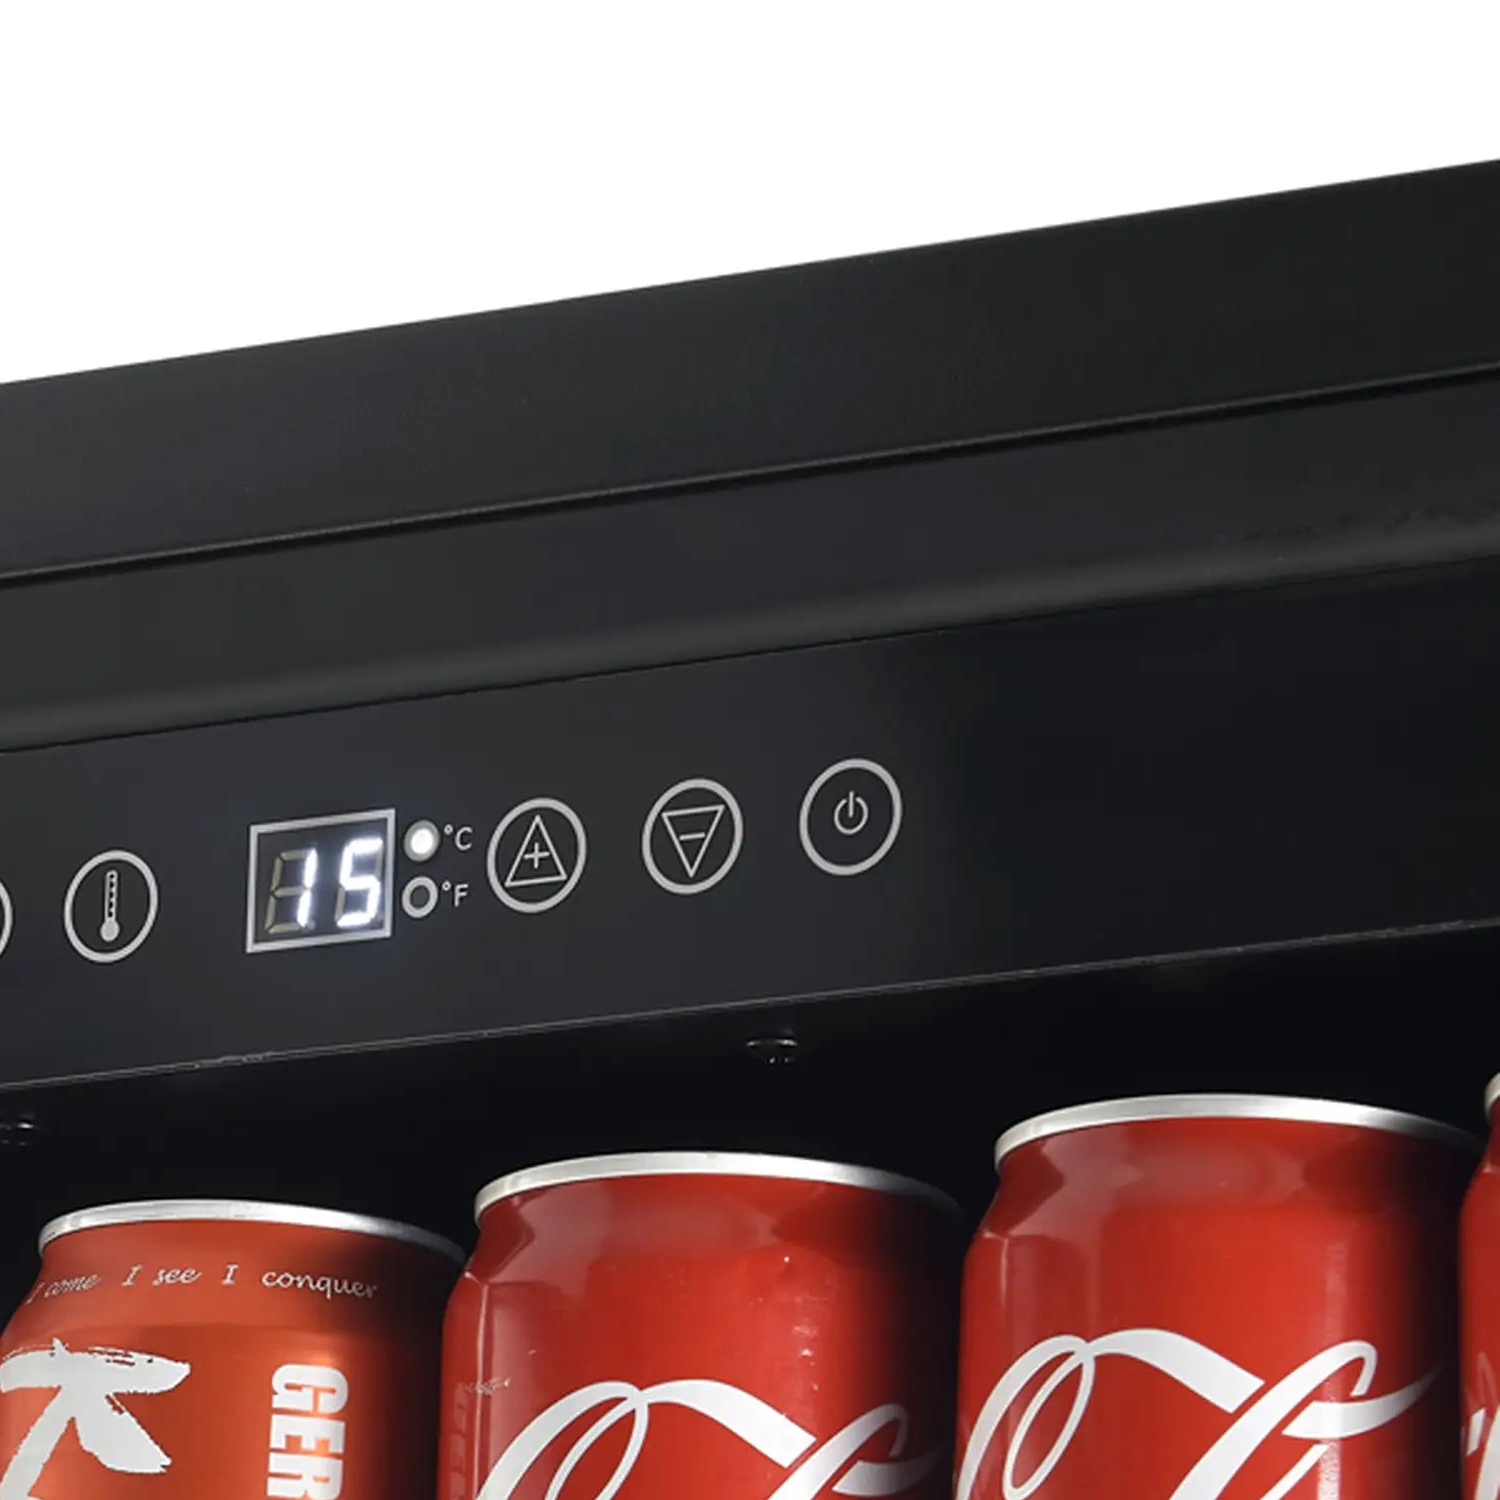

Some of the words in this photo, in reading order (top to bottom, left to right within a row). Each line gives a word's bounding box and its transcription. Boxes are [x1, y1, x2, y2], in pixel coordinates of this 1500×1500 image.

[297, 837, 384, 929] 15
[44, 1272, 101, 1298] come
[122, 1264, 143, 1286] I
[152, 1266, 202, 1287] see
[222, 1264, 238, 1285] I
[262, 1269, 377, 1299] conquer
